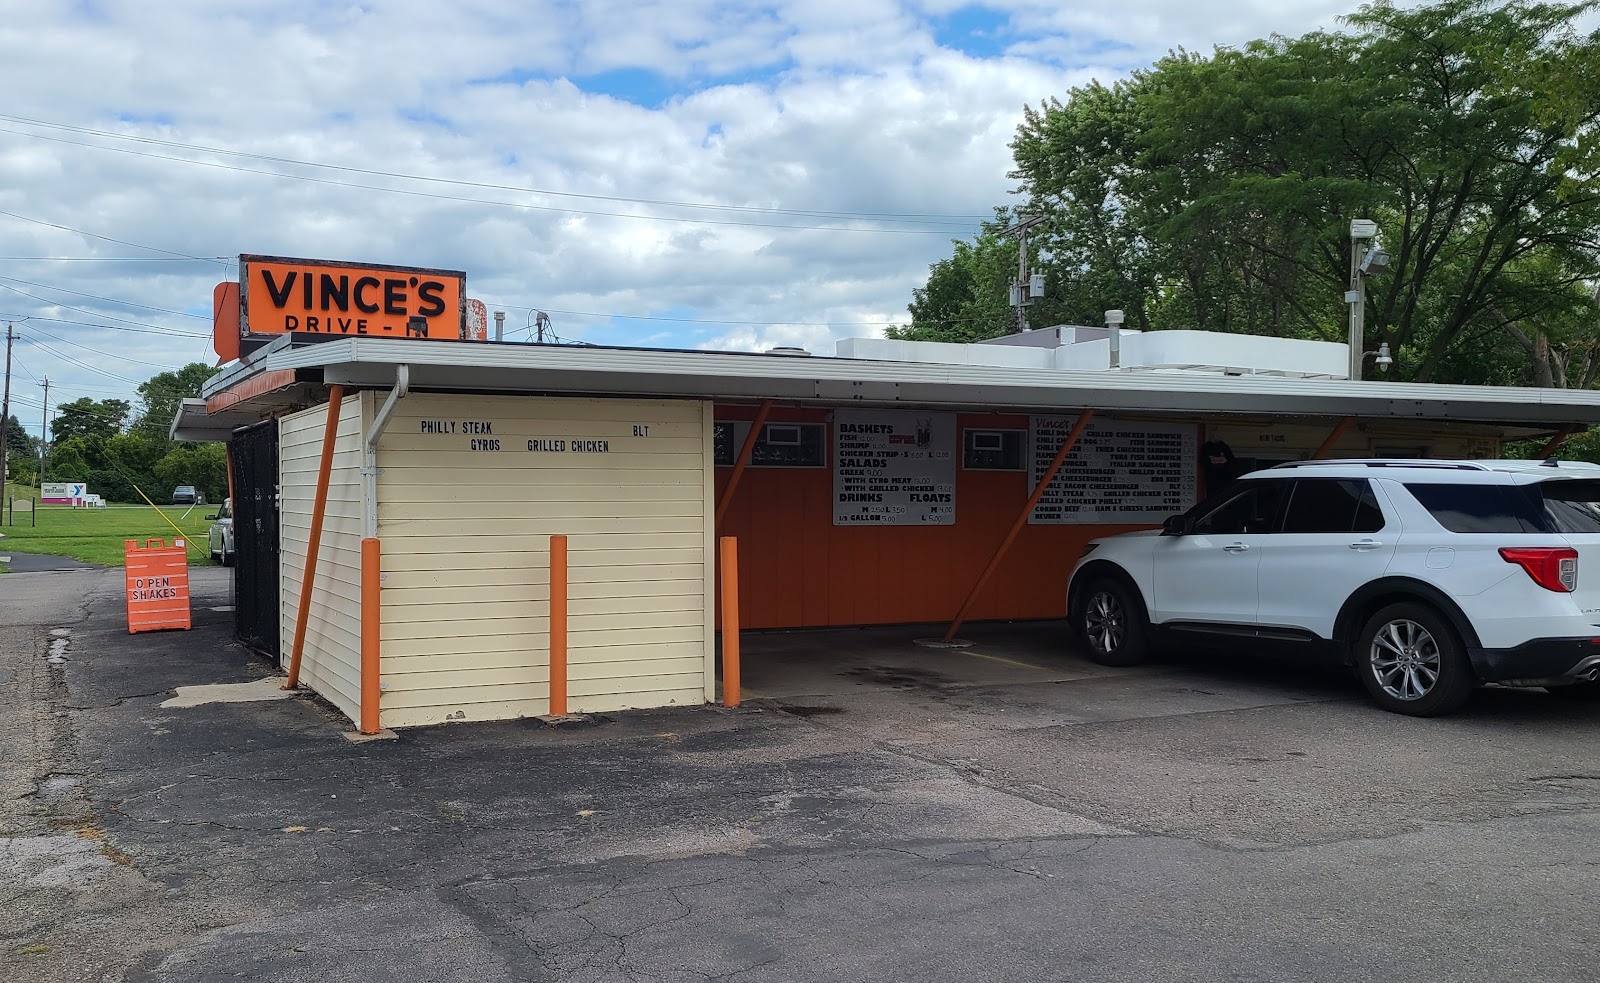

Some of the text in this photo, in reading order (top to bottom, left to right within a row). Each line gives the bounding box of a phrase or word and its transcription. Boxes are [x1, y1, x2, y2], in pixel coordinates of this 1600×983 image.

[261, 269, 446, 318] VINCE'S
[285, 315, 368, 334] DRIVE
[421, 421, 492, 434] PHILLY STEAK
[633, 425, 649, 437] BLT
[840, 424, 894, 434] BASKETS
[471, 439, 500, 451] GYROS
[527, 440, 609, 452] GRILLED CHICKEN
[840, 459, 887, 468] SALADS
[839, 494, 883, 502] DRINKS
[910, 494, 951, 502] FLOATS
[136, 577, 169, 588] OPEN
[133, 588, 176, 599] SHAKES
